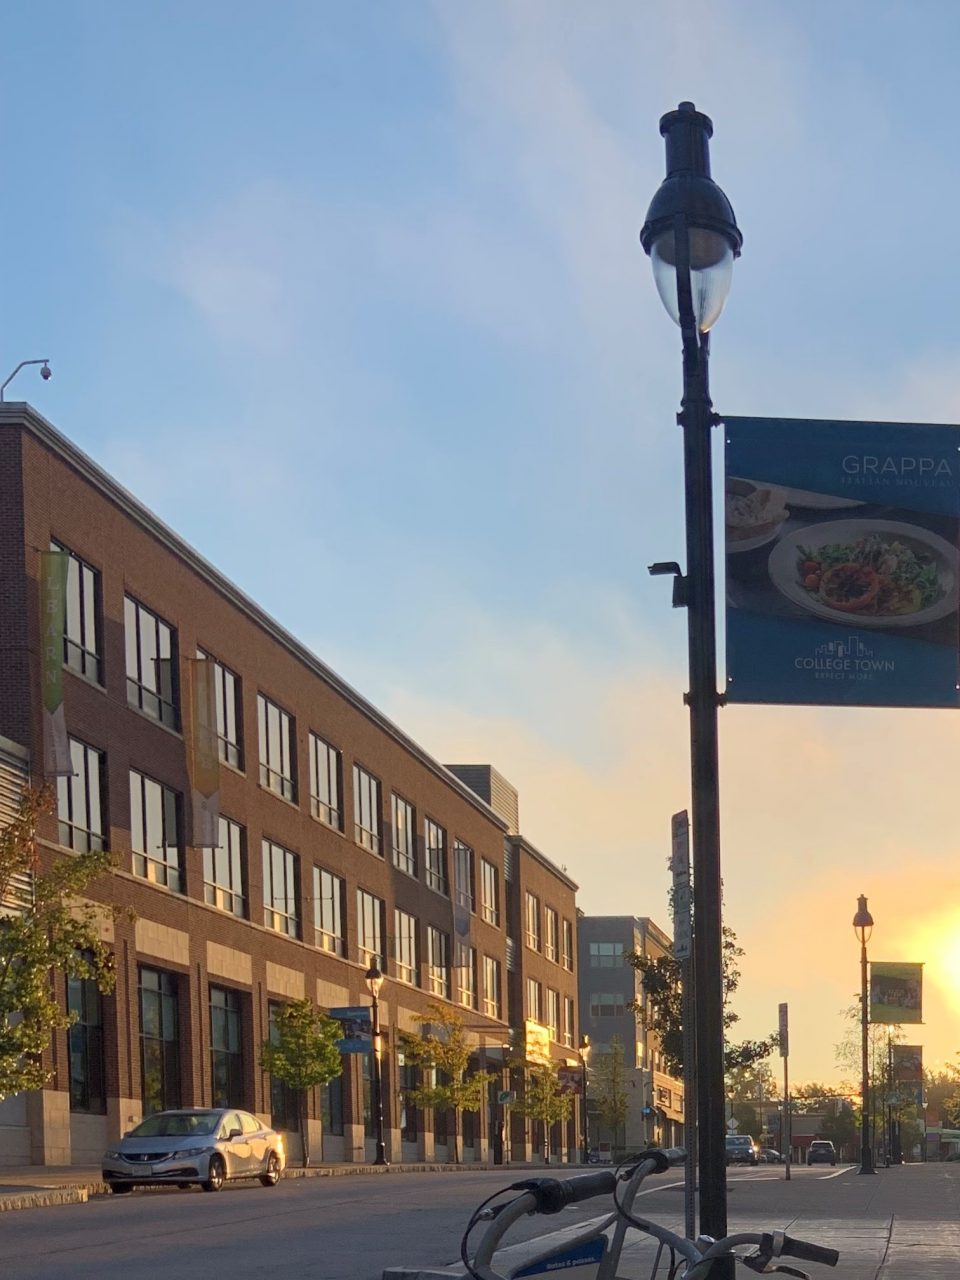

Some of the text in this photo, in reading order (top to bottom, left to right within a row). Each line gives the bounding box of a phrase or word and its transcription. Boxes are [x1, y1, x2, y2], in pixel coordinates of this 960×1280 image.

[842, 455, 953, 477] GRAPPA
[794, 657, 895, 671] COLLEGE TOWN
